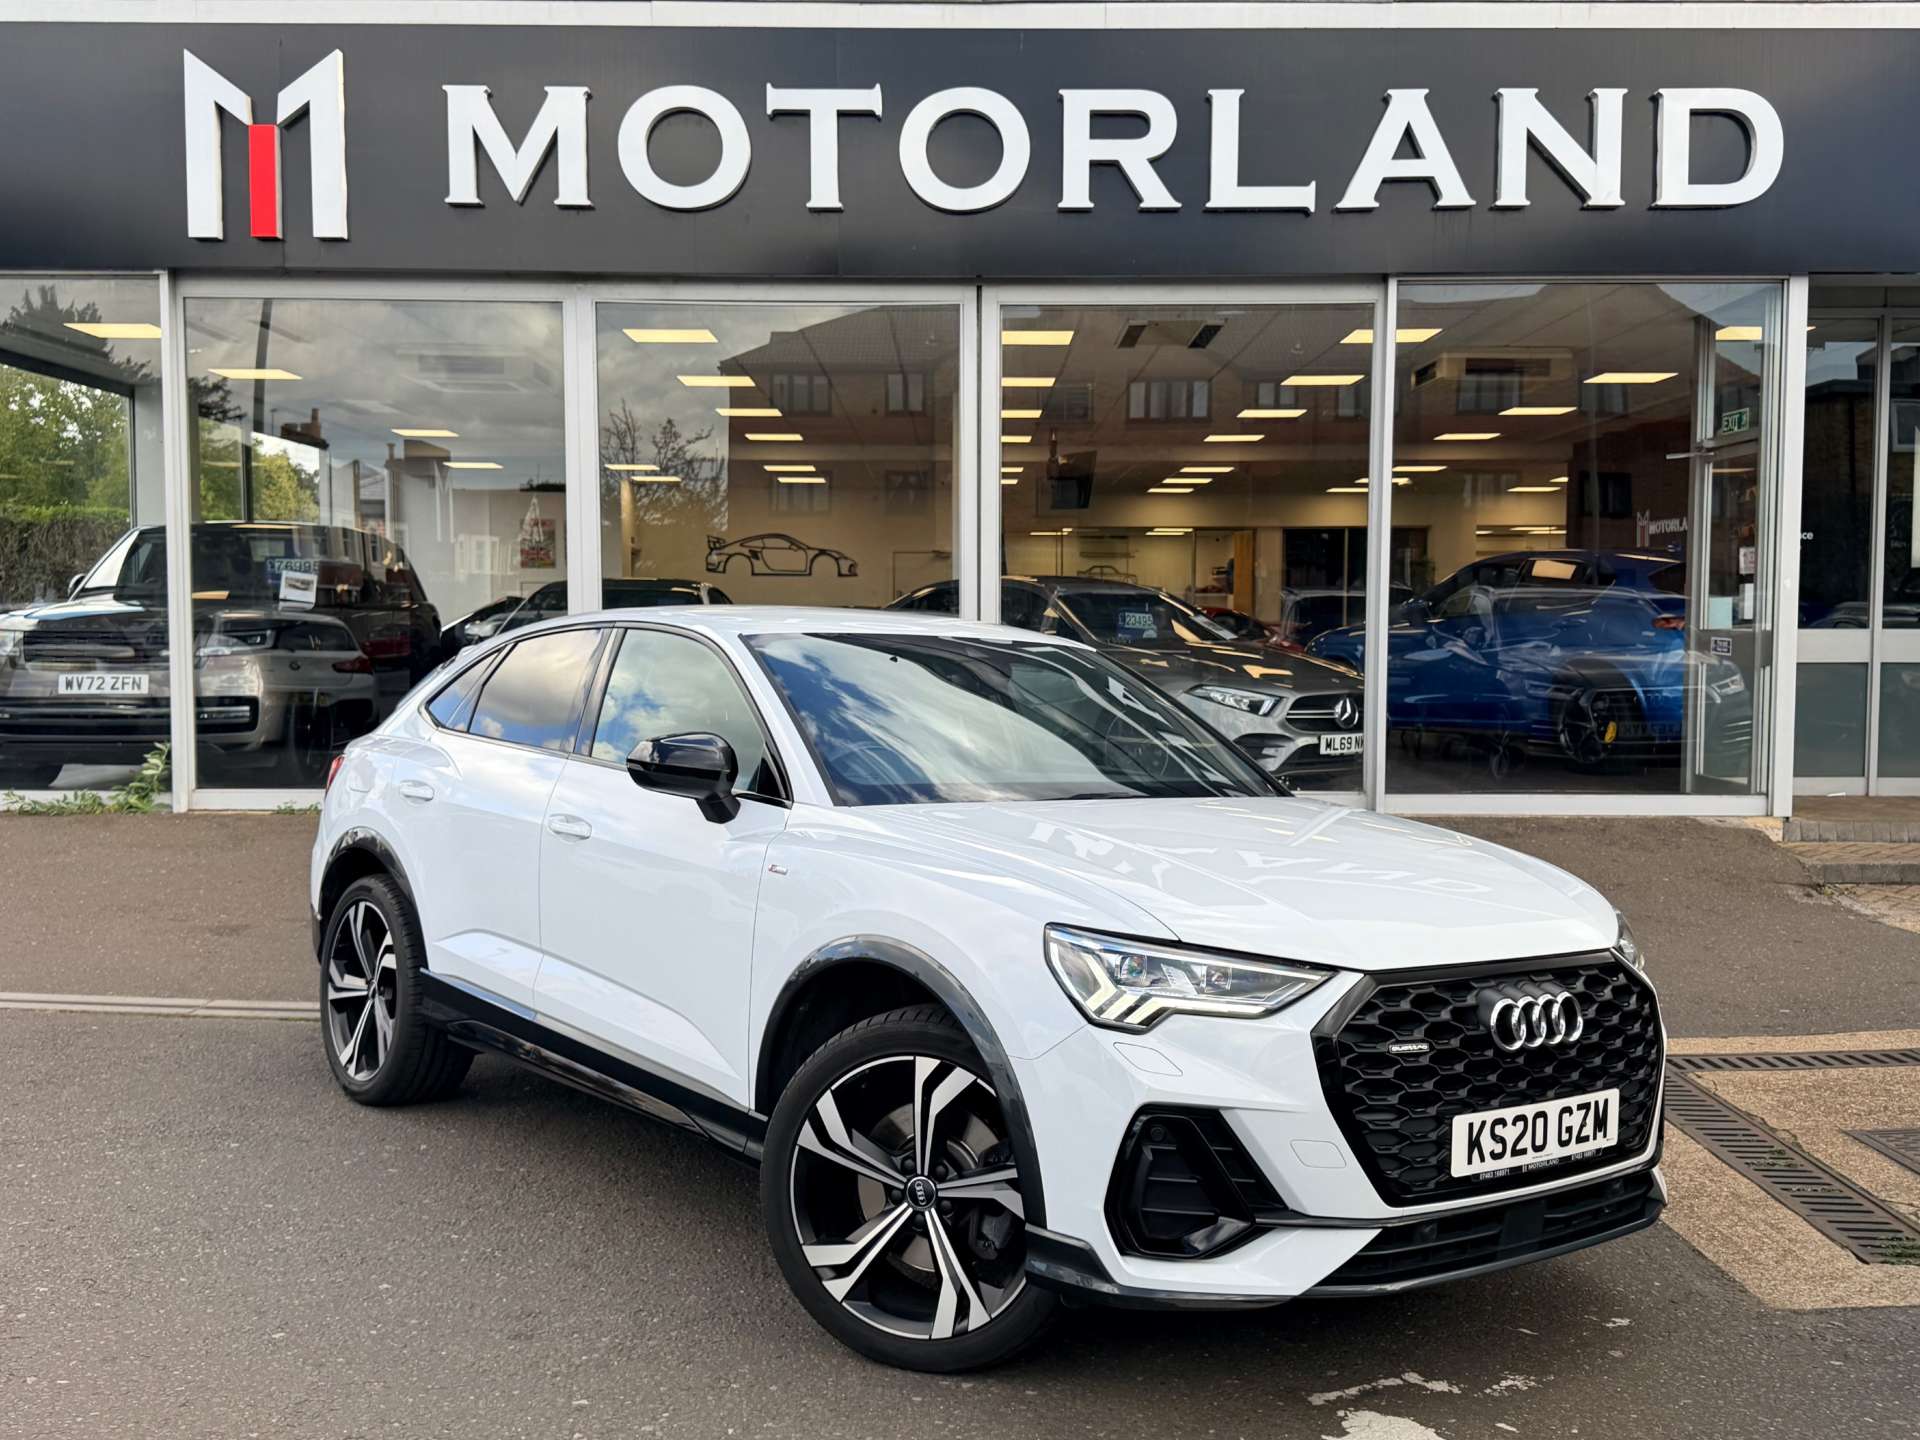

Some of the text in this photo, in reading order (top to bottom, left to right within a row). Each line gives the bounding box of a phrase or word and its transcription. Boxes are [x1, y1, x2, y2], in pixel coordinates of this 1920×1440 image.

[442, 83, 1786, 213] MOTORLAND
[1721, 415, 1740, 432] EXIT
[65, 676, 142, 691] WV72 ZFN
[1325, 736, 1353, 752] ML69
[1466, 1098, 1609, 1166] KS20 GZM
